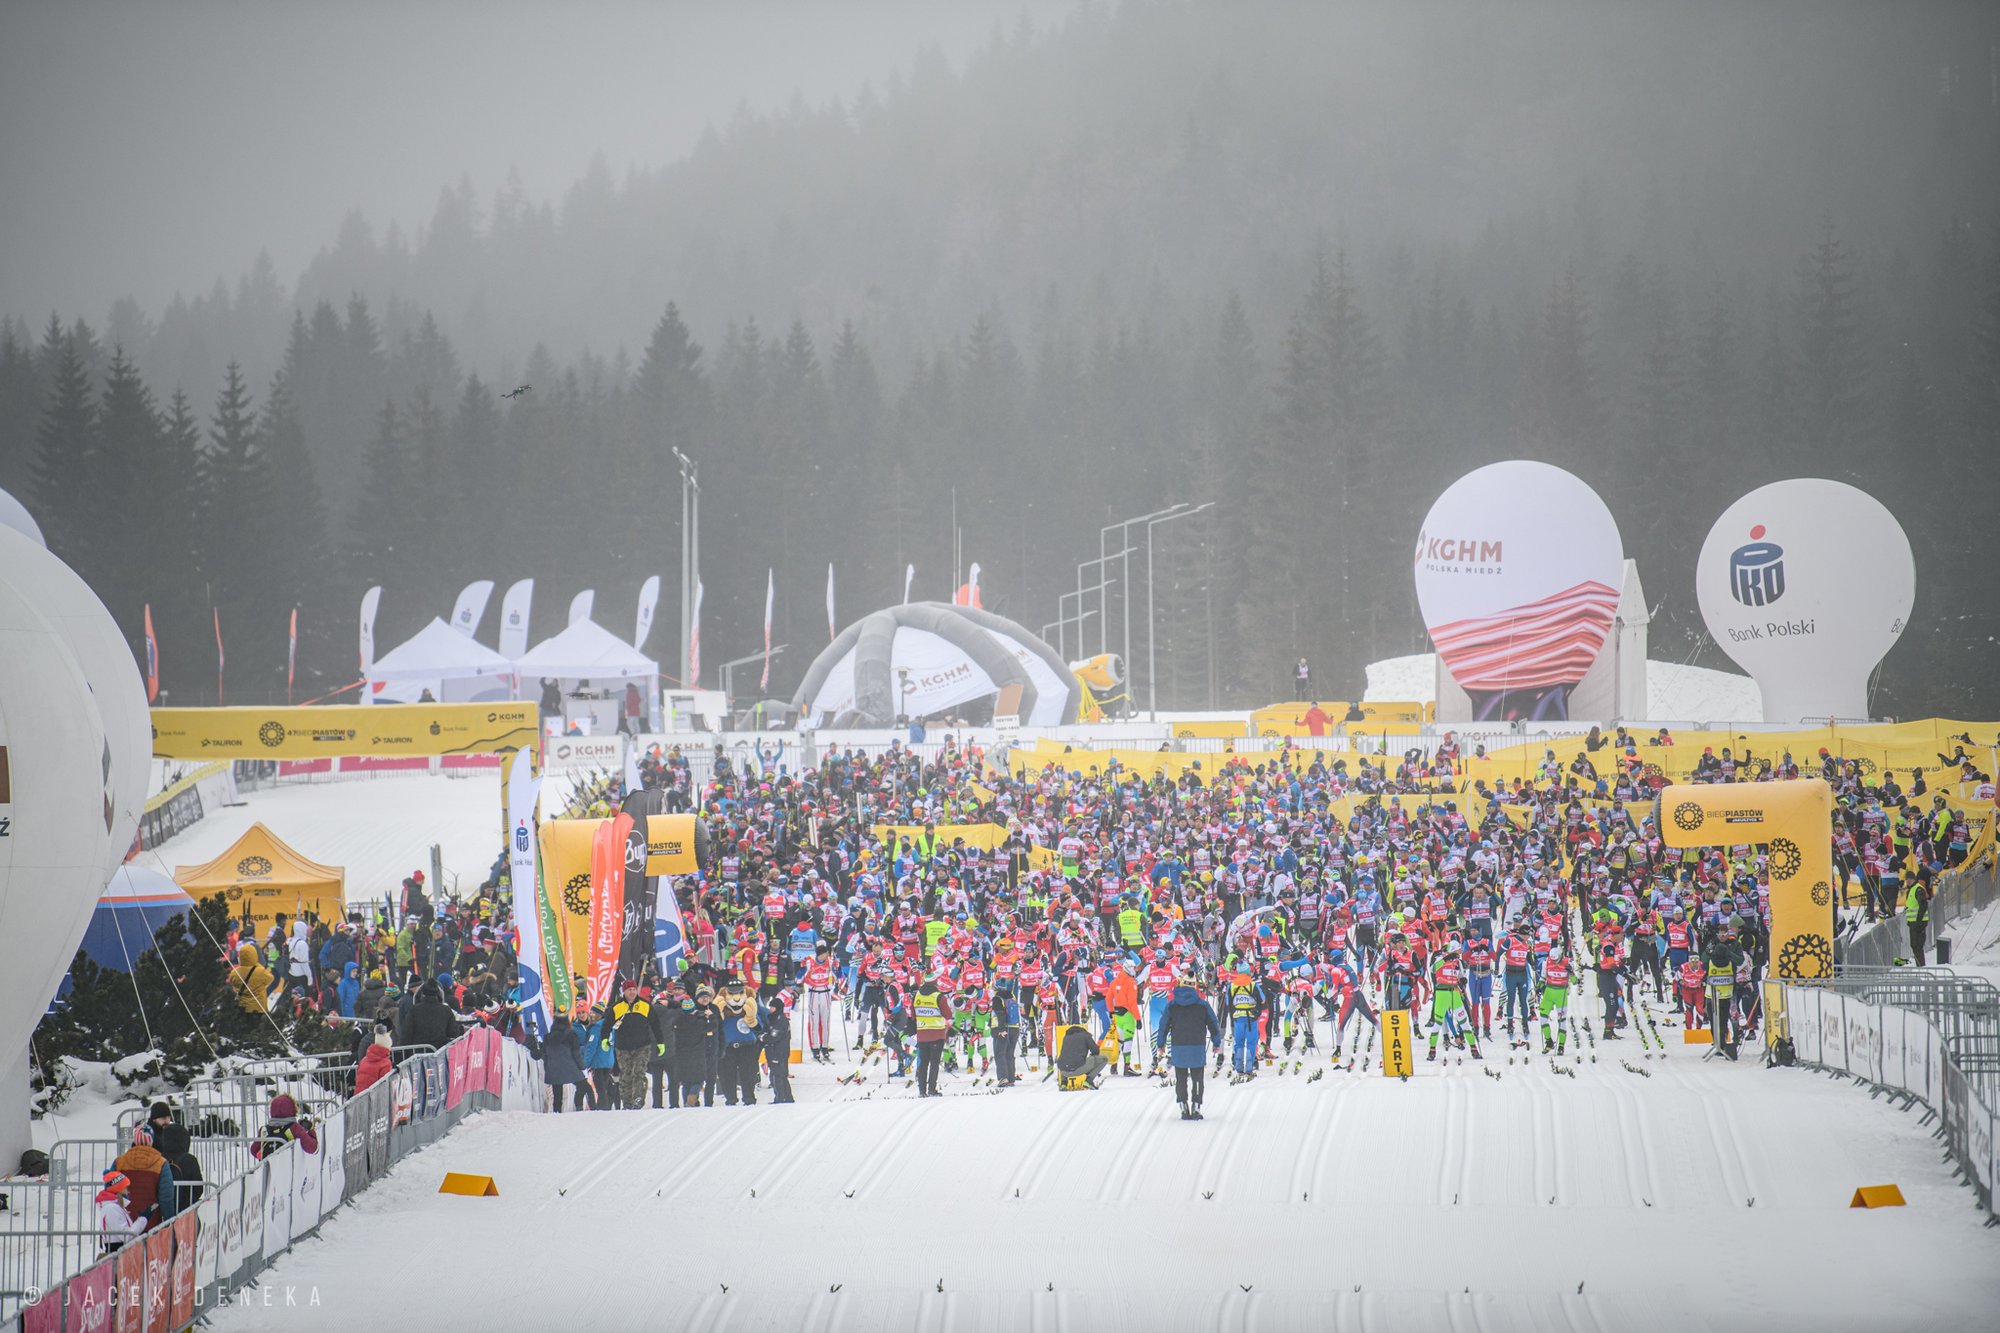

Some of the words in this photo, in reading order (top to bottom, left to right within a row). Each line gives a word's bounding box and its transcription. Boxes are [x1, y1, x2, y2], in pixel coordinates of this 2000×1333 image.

[1427, 537, 1503, 562] KGHM
[1426, 564, 1459, 573] POLSKA
[1465, 565, 1503, 575] MIEDŹ
[1728, 624, 1763, 642] Bank
[1766, 619, 1815, 637] Polski
[920, 663, 970, 687] KGHM
[575, 745, 615, 755] KGHM
[1390, 1014, 1402, 1073] START
